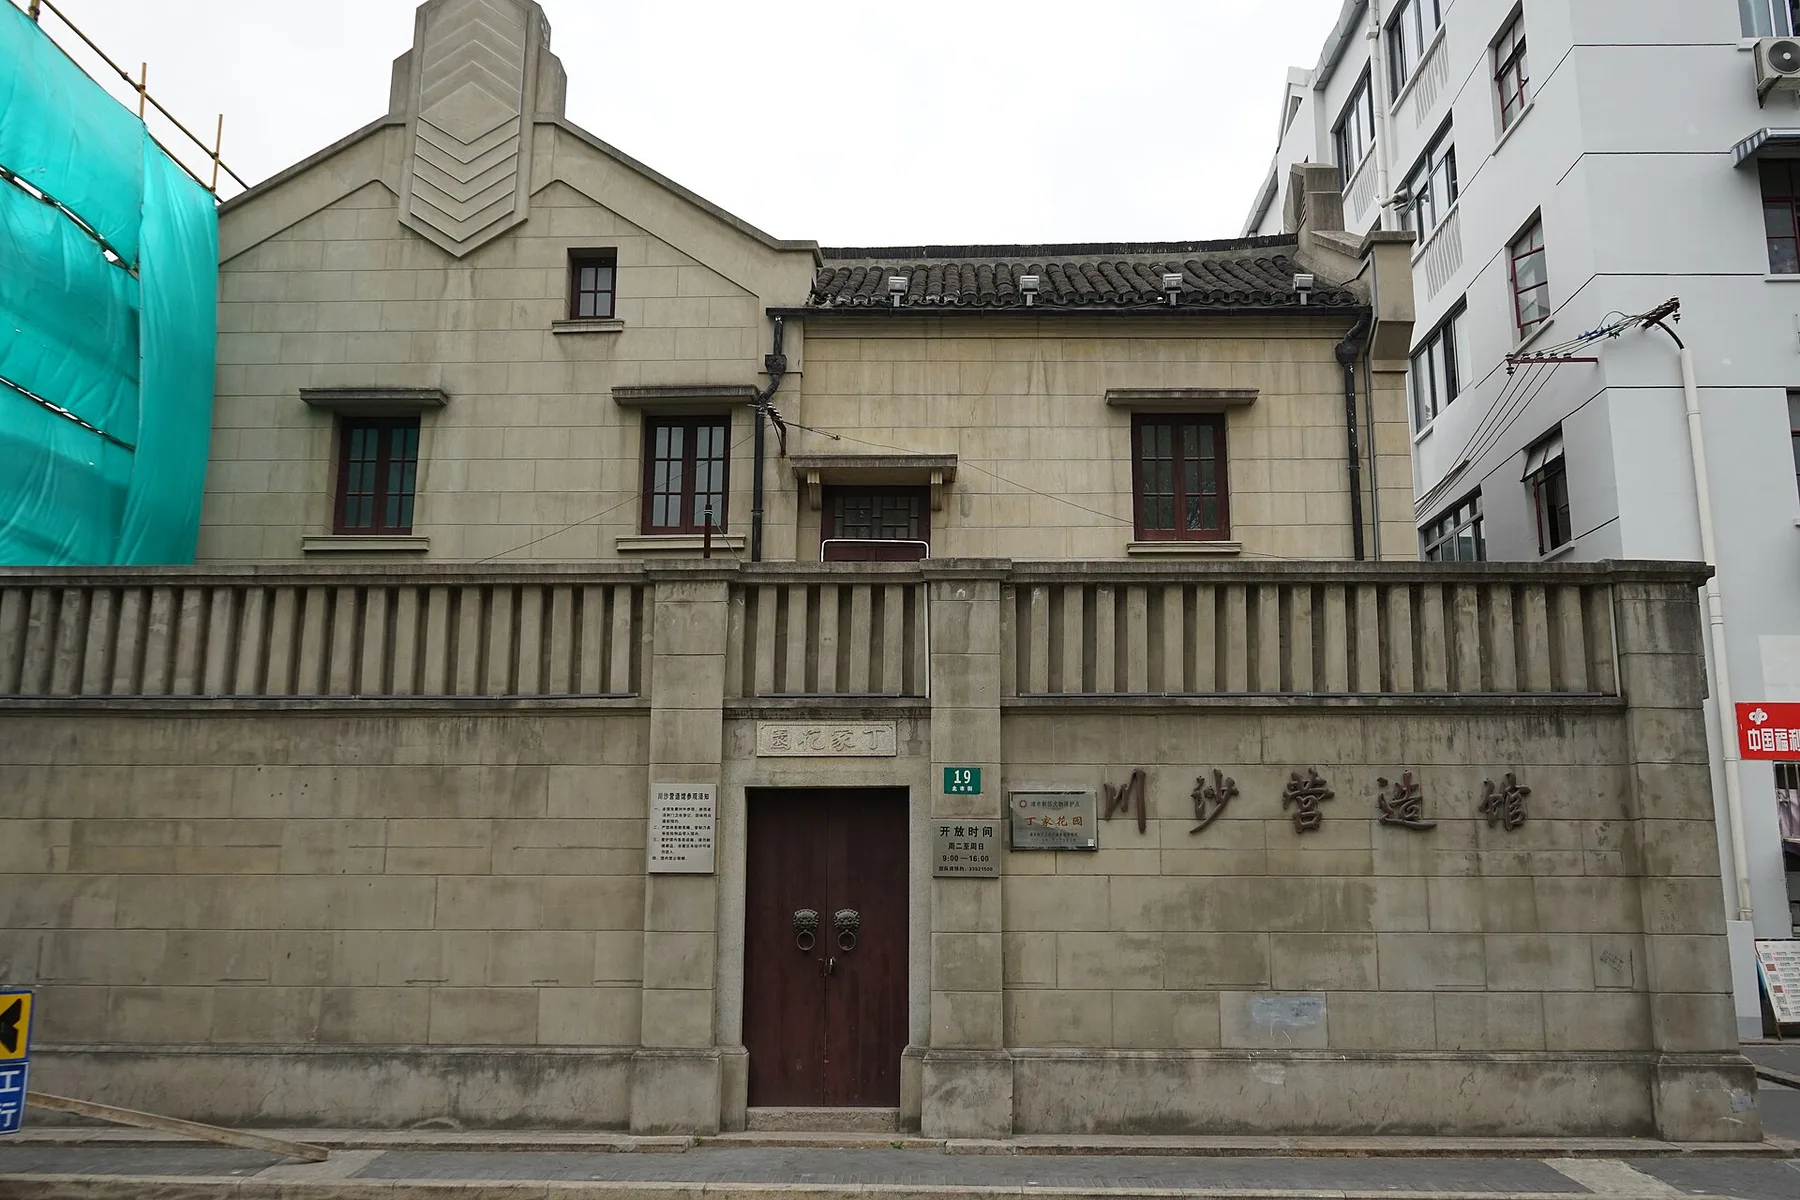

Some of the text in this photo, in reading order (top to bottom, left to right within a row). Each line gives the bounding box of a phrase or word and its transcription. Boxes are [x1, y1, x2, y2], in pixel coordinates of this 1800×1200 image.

[953, 769, 971, 784] 19
[1103, 766, 1532, 834] 川沙营造馆
[1024, 814, 1083, 827] 丁家花园
[939, 826, 993, 838] 开放时间
[948, 842, 984, 851] 周二至周日
